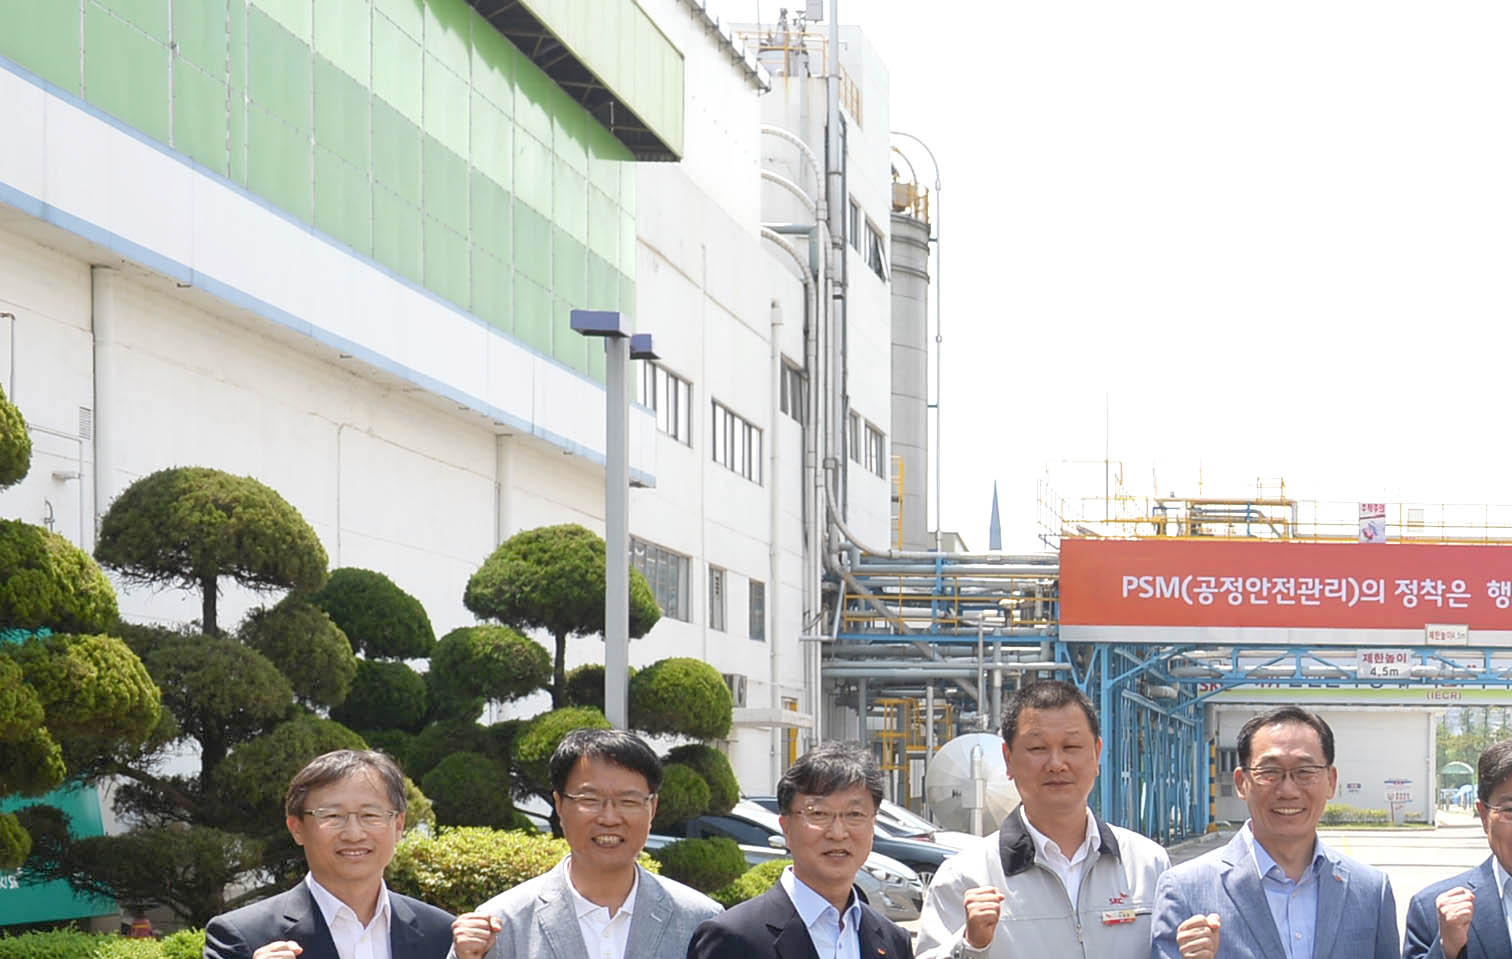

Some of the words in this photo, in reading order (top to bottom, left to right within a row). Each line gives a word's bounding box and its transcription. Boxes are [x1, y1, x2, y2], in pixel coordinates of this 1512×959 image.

[1121, 575, 1385, 607] PSM(공정안전관리)의
[1394, 579, 1471, 609] 정착은
[1362, 653, 1407, 664] 제한높이
[1370, 666, 1399, 677] 4.5m
